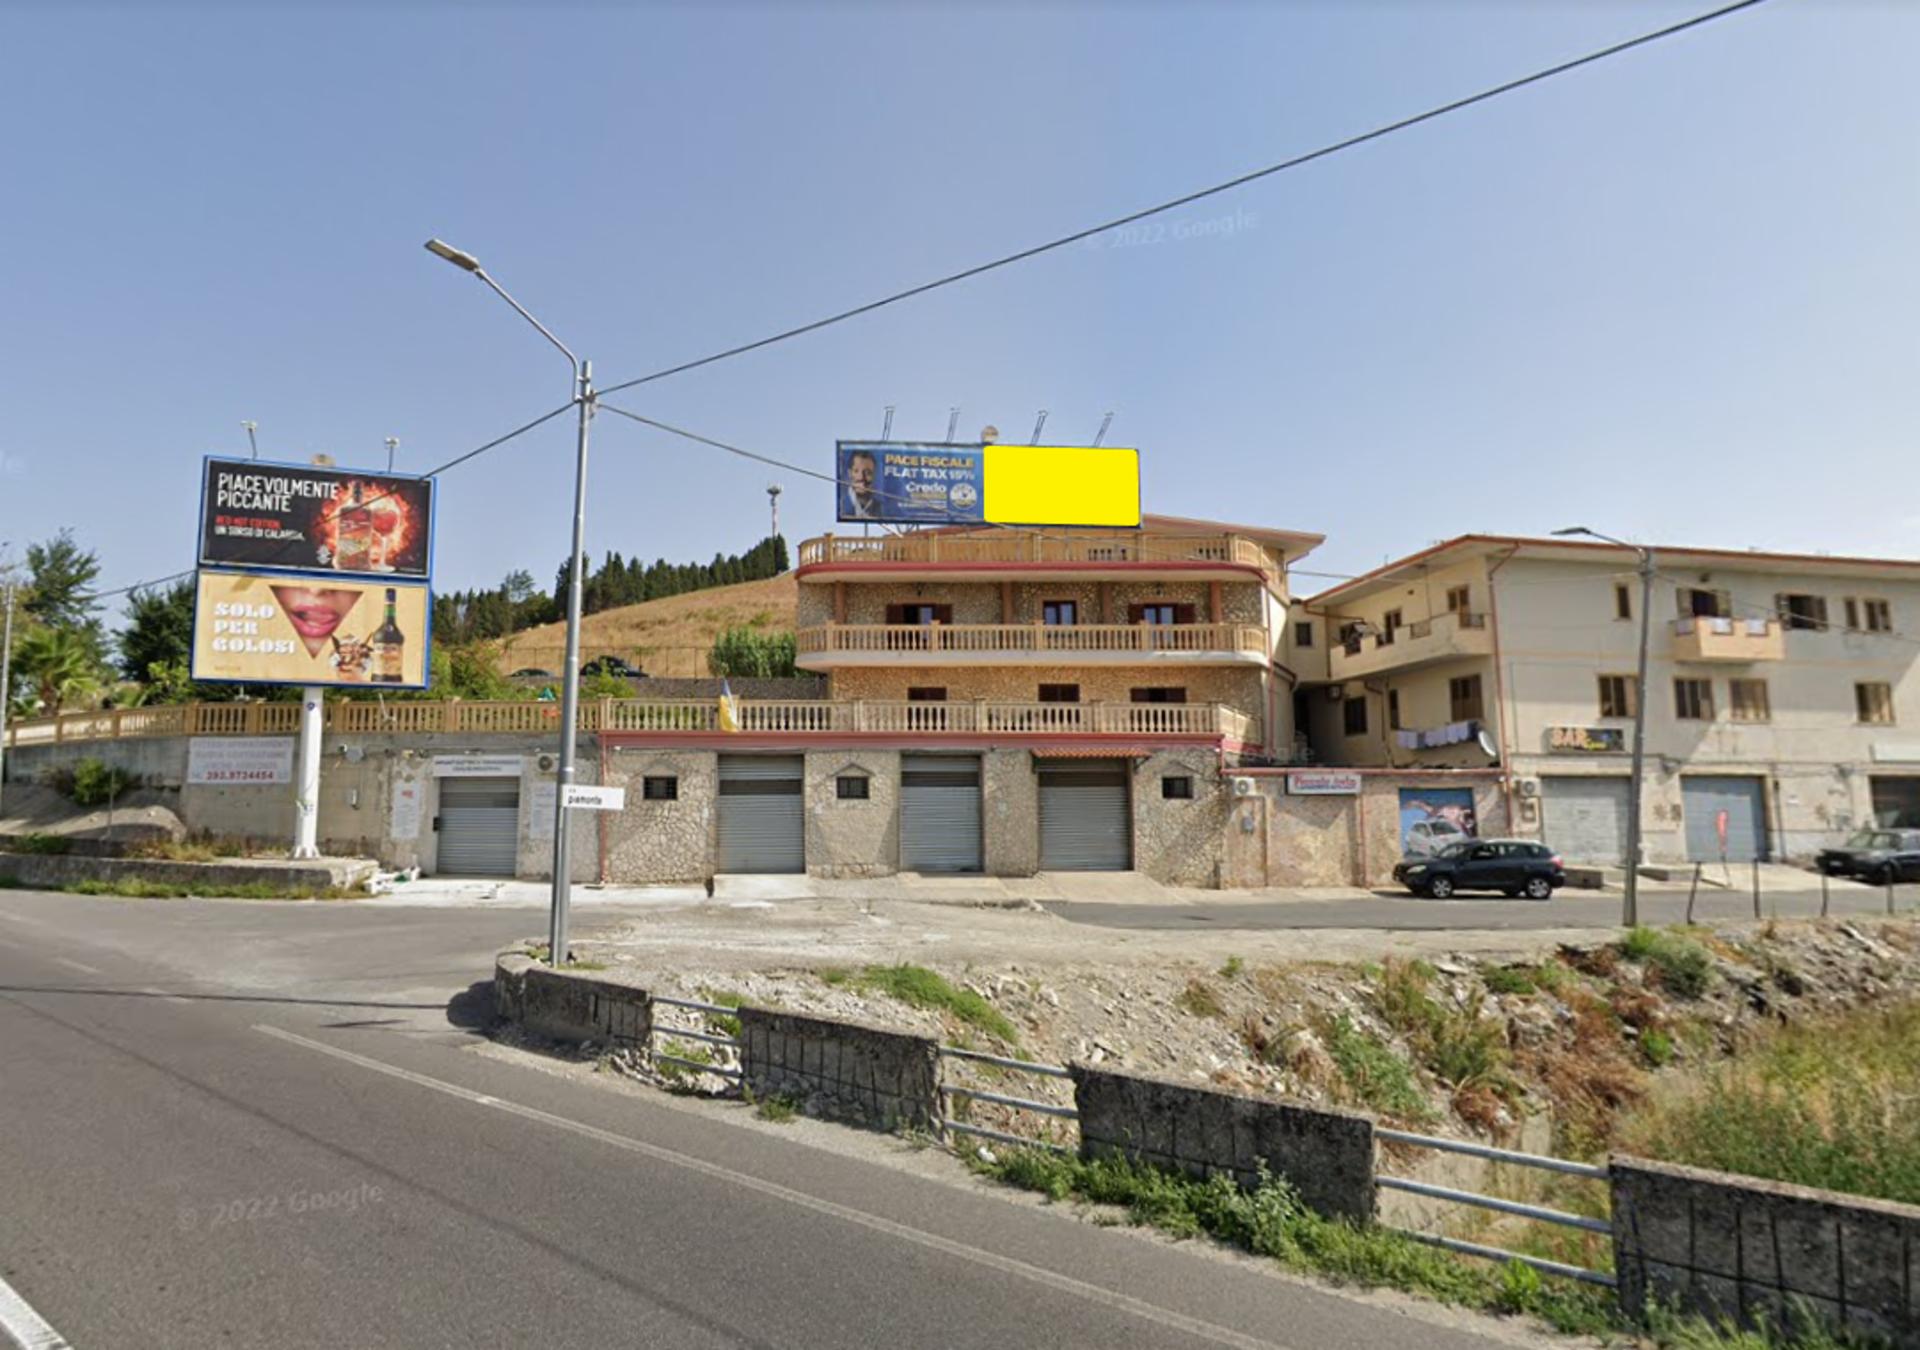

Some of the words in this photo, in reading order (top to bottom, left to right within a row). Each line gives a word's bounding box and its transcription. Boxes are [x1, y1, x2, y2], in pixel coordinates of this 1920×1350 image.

[885, 454, 918, 466] PACE
[921, 456, 975, 468] FISCALE
[884, 465, 918, 478] FLAT
[920, 467, 948, 480] TAX
[218, 472, 339, 500] PIACEVOLMENTE
[905, 481, 947, 493] Credo
[217, 490, 292, 513] PICCANTE
[213, 602, 275, 620] SOLO
[213, 620, 257, 636] PER
[1551, 727, 1587, 747] BAR
